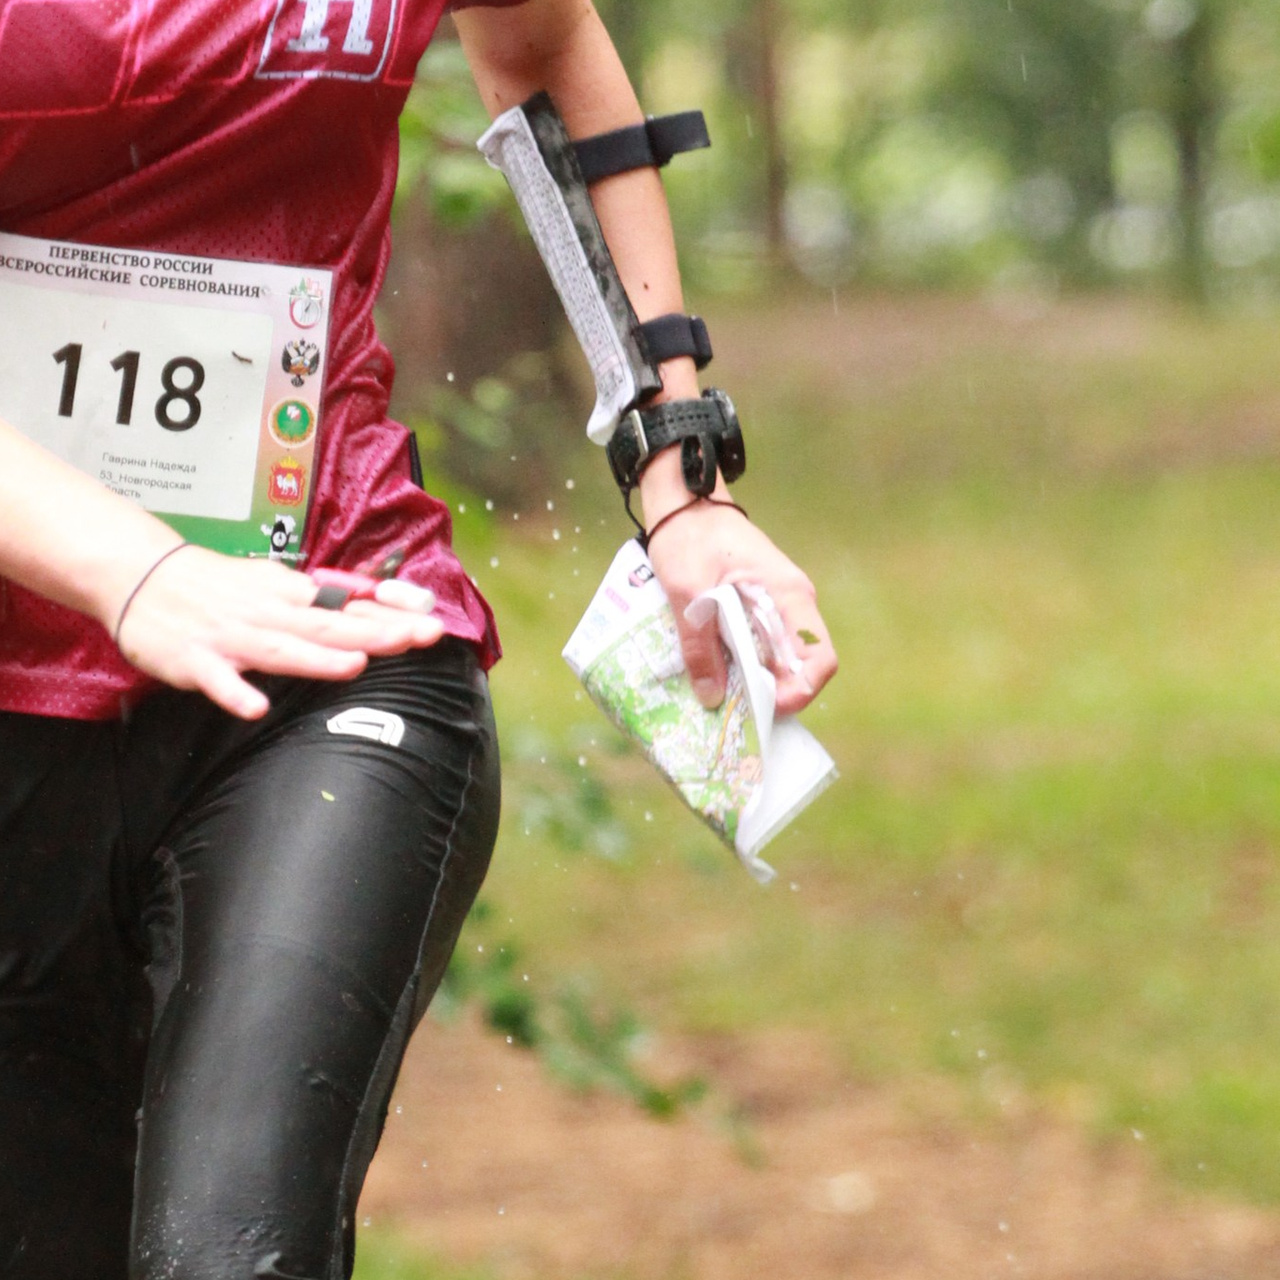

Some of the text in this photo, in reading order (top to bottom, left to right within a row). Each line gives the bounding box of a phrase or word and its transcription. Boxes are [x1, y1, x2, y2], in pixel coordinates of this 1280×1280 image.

[48, 245, 214, 276] ПЕРВЕНСТВО РОССИИ
[139, 274, 261, 299] СОРЕВНОВАНИЯ
[52, 341, 206, 433] 118
[149, 458, 197, 474] Надежда
